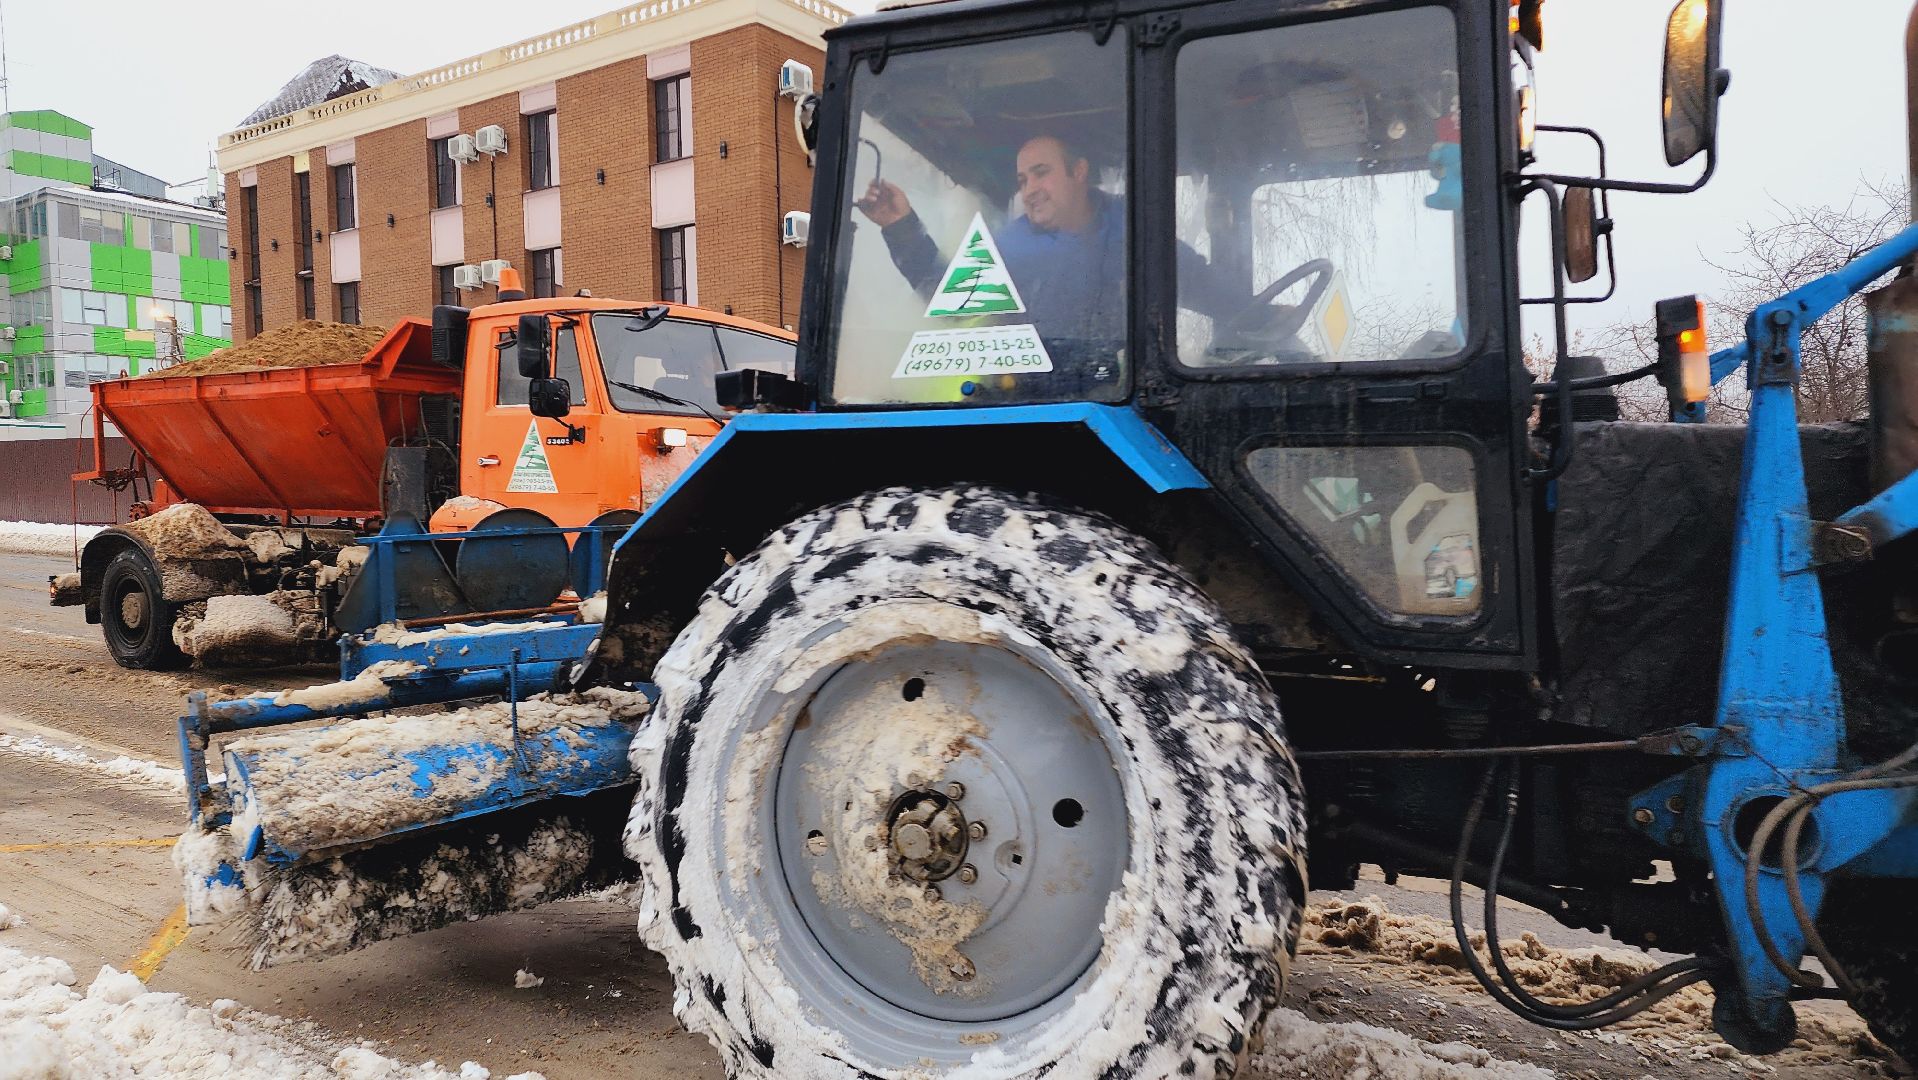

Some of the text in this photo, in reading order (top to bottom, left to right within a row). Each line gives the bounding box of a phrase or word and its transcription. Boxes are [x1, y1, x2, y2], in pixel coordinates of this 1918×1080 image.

[911, 337, 1036, 358] (926) 903-15-25
[904, 354, 1042, 375] (49679) 7-40-50
